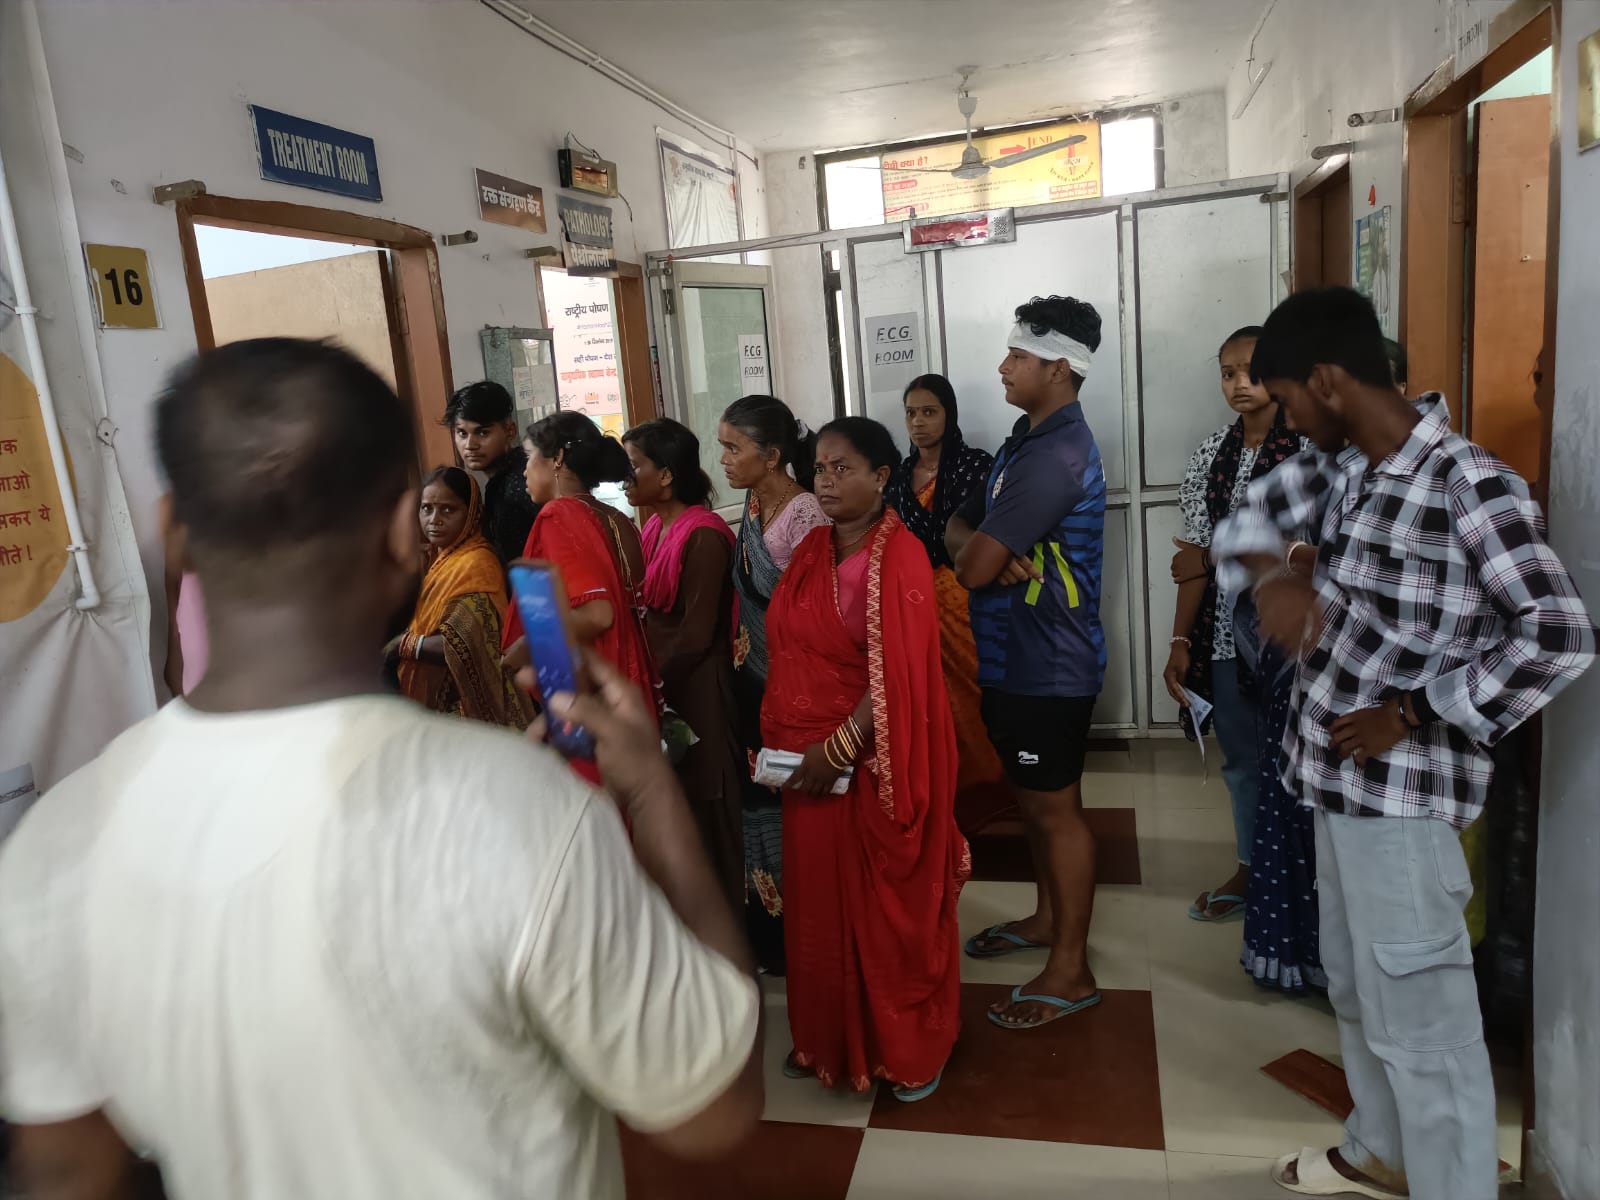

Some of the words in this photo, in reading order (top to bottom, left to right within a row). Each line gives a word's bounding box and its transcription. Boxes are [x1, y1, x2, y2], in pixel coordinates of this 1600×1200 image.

[267, 128, 336, 178] TREATMENT
[335, 145, 369, 185] ROOM
[498, 186, 527, 213] संग्रहण
[563, 207, 610, 239] PATHOLOGY
[104, 267, 143, 306] 16
[564, 303, 588, 319] राष्ट्रीय
[588, 301, 609, 314] पोषण
[876, 325, 910, 342] ECG
[744, 344, 761, 357] ECG
[875, 349, 914, 364] ROOM
[744, 366, 764, 376] ROOM
[38, 503, 51, 522] ये
